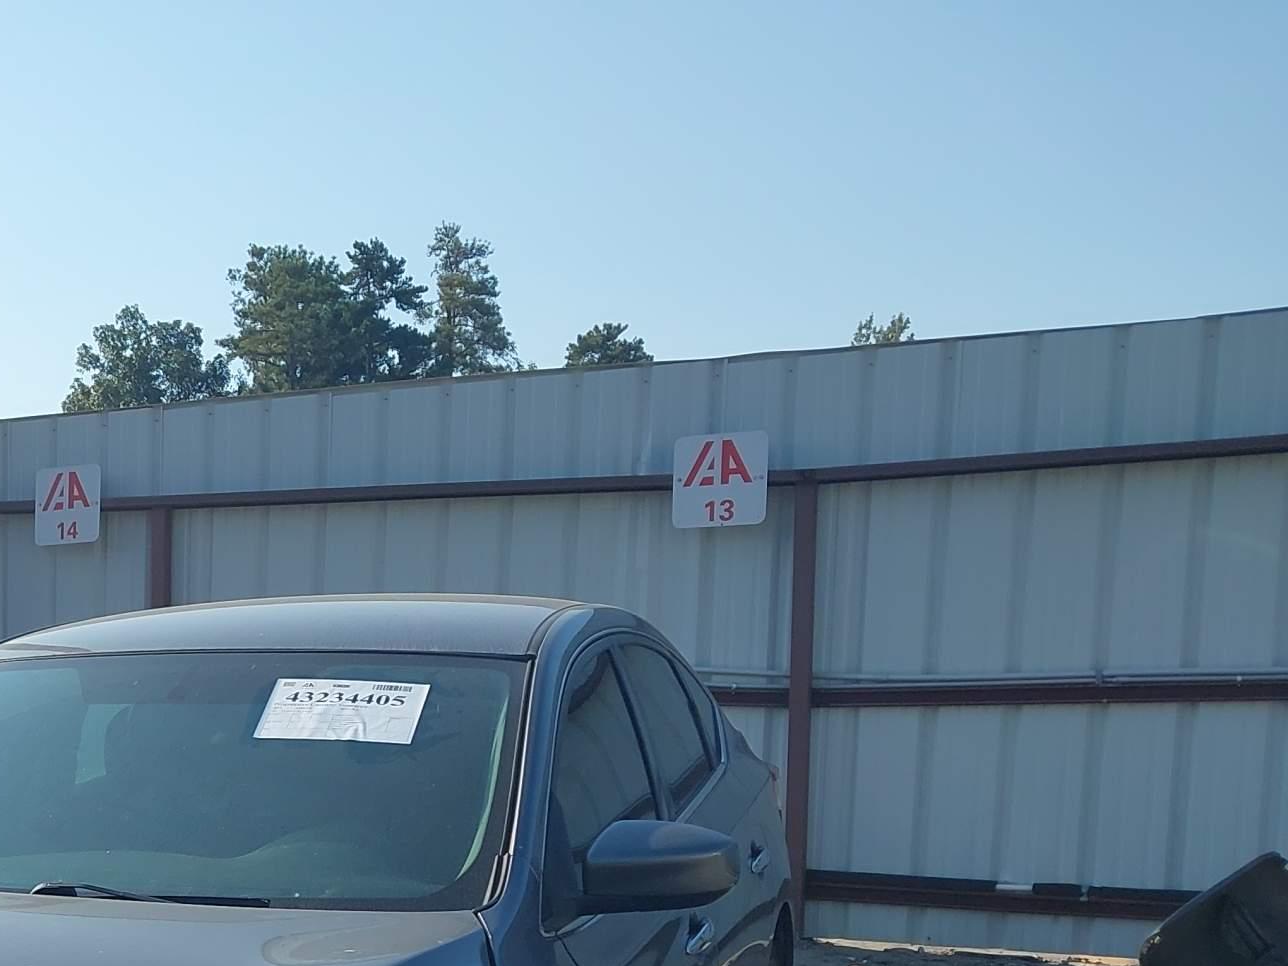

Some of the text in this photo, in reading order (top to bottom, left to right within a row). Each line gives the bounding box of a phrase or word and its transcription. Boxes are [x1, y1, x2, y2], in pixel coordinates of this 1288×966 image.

[705, 500, 735, 522] 13
[57, 521, 79, 540] 14
[286, 691, 408, 707] 43234405
